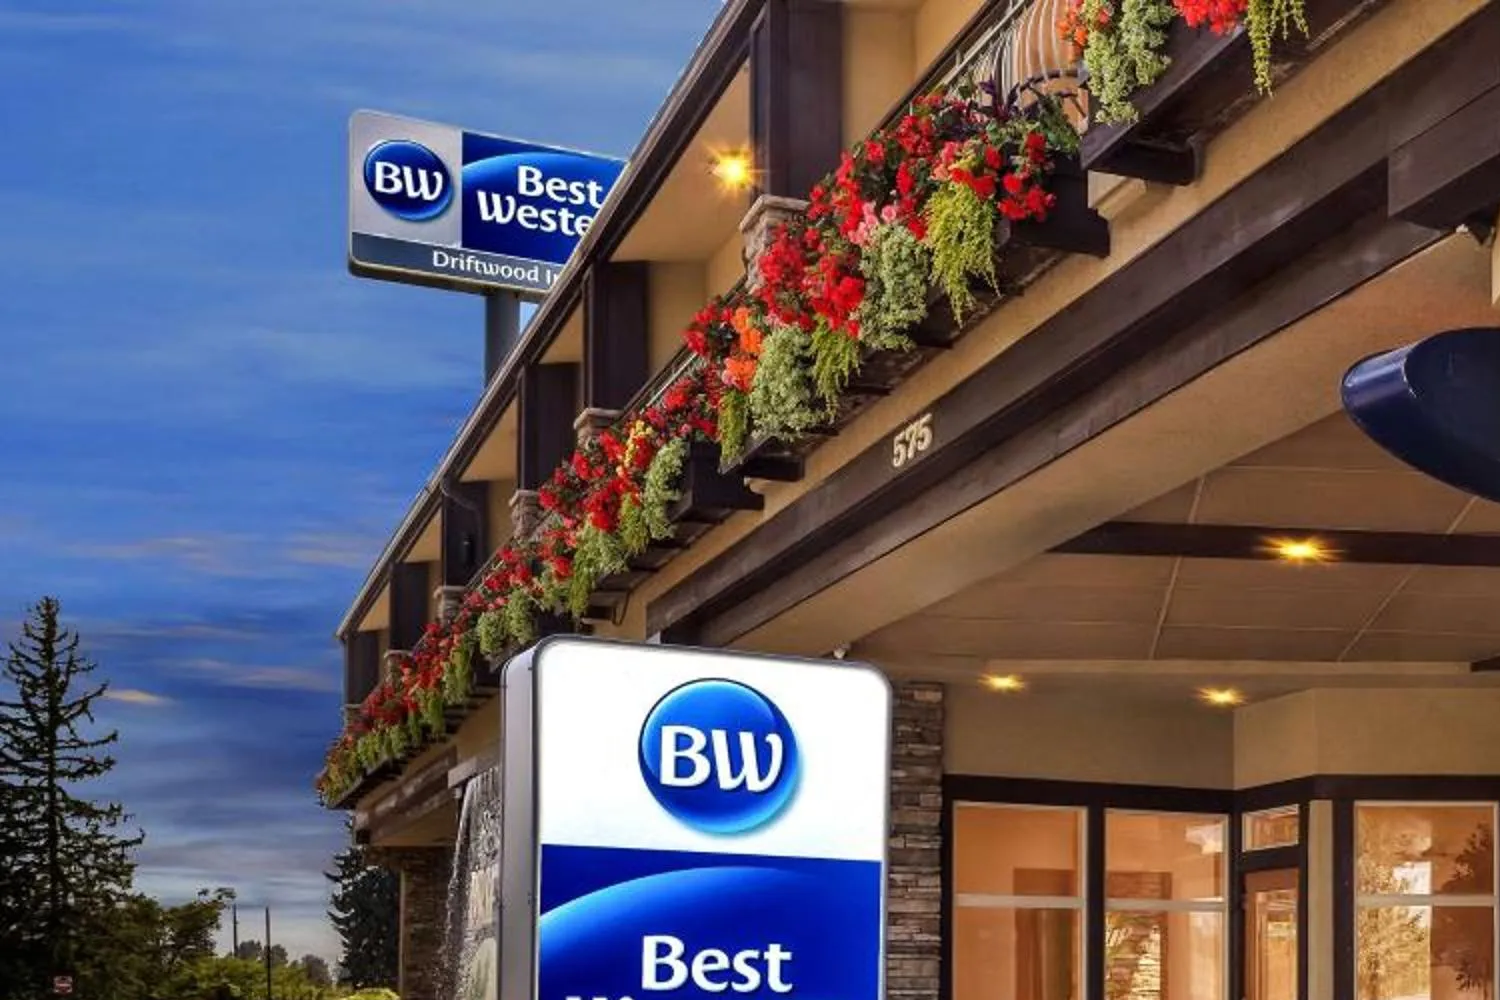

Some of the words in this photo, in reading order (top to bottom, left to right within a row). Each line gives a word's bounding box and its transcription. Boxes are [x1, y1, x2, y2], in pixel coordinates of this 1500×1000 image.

[373, 161, 443, 201] BW
[517, 166, 602, 209] Best
[477, 190, 595, 236] Weste
[433, 251, 540, 282] Driftwood
[893, 413, 932, 467] 575
[659, 725, 783, 793] BW
[641, 935, 793, 993] Best
